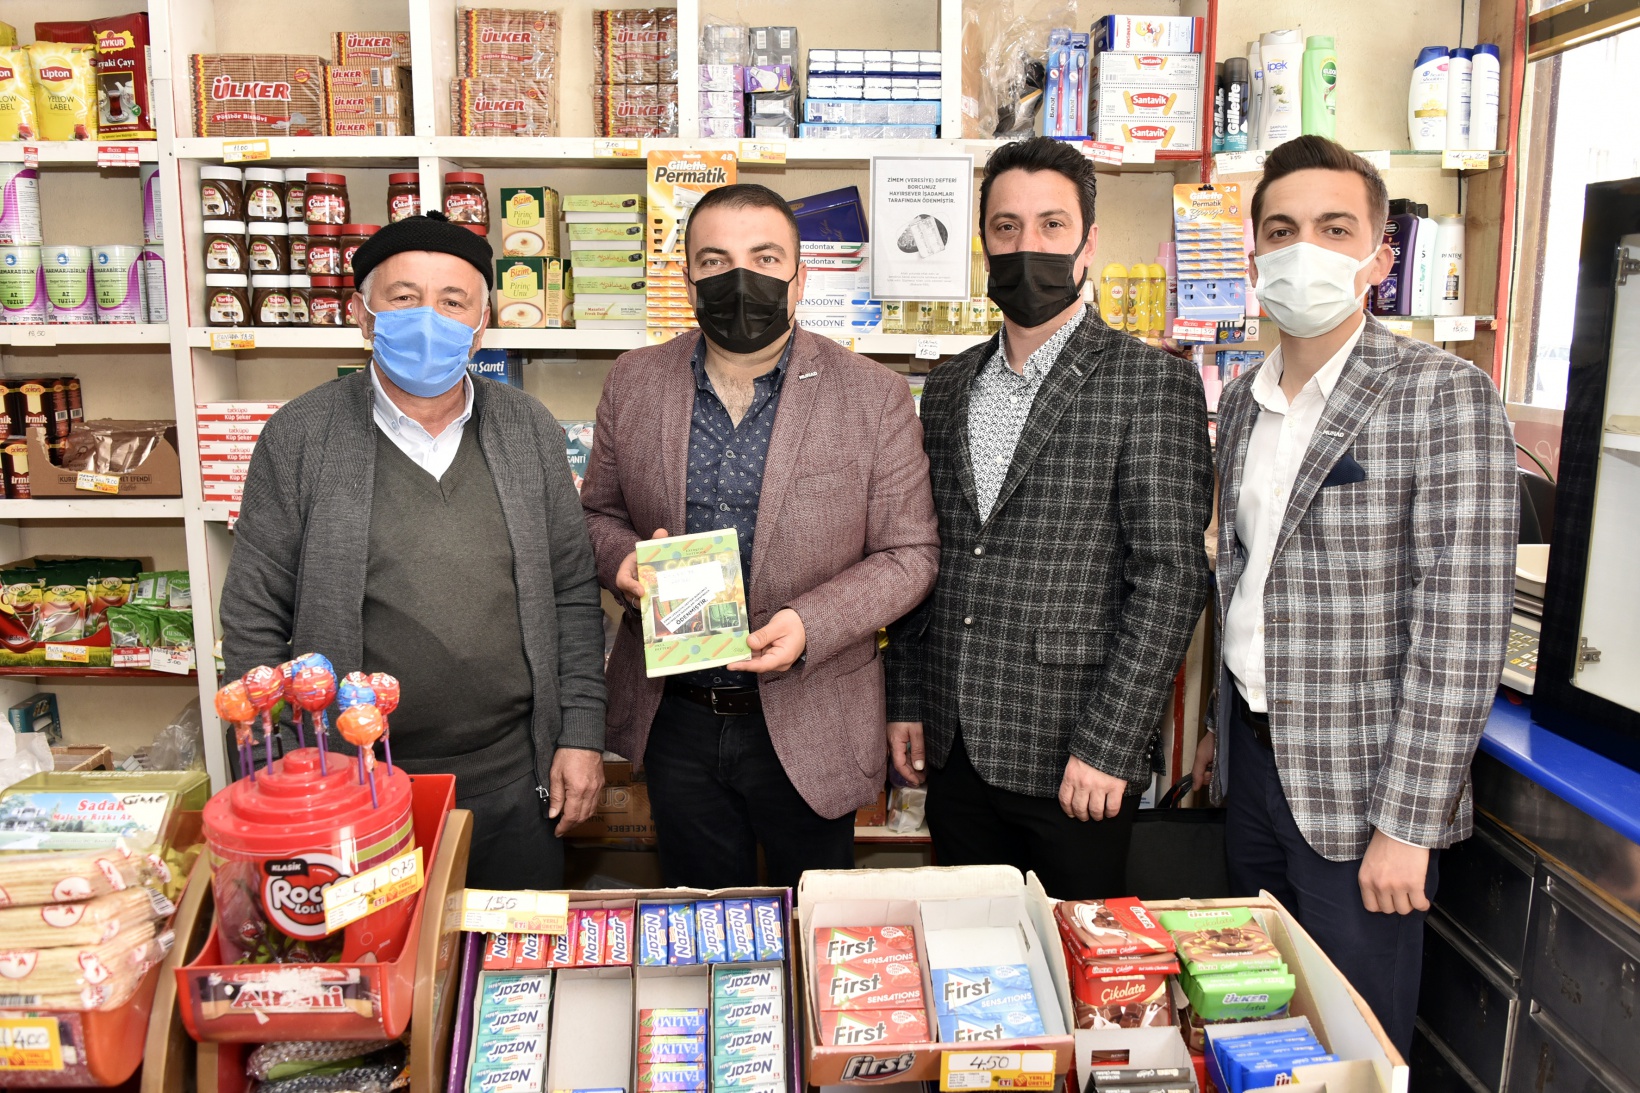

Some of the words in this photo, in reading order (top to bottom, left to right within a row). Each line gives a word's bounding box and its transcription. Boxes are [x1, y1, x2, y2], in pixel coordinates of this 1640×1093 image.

[347, 34, 392, 48] ÜLKER
[481, 27, 531, 44] ÜLKER
[616, 28, 668, 44] ÜLKER
[98, 60, 116, 68] ryaki
[118, 58, 135, 68] Çayı
[1139, 57, 1163, 65] Santavik
[1267, 60, 1288, 72] ipek
[42, 69, 70, 79] Lipton
[332, 68, 362, 78] ÜLKER
[1254, 69, 1264, 80] ip
[212, 75, 292, 101] ÜLKER
[334, 96, 364, 106] ÜLKER
[474, 97, 526, 112] ÜLKER
[1132, 95, 1167, 105] Santavik
[616, 101, 668, 118] ÜLKER
[1214, 87, 1225, 138] Gillette
[1226, 83, 1241, 135] Gillette
[336, 122, 366, 132] ÜLKER
[1131, 128, 1166, 137] Santavik
[721, 154, 733, 162] 48
[668, 160, 707, 171] Gillette
[655, 166, 726, 184] Permatik
[204, 188, 216, 196] orku
[1190, 192, 1223, 200] Gillette
[512, 196, 534, 207] Bizim
[1192, 200, 1222, 208] Permatik
[513, 210, 532, 220] Pirinç
[516, 218, 530, 226] Unu
[510, 266, 532, 278] Bizim
[510, 282, 531, 292] Pirinç
[311, 301, 339, 312] Çokokrem
[478, 361, 505, 373] Santi
[26, 415, 48, 424] irmik
[238, 434, 252, 442] Şeker
[12, 476, 30, 484] irmi
[230, 474, 240, 482] Küp
[676, 598, 708, 625] ÖDENMİŞTİR.
[606, 825, 647, 833] KELEBEK
[271, 862, 302, 872] KLASİK
[1130, 906, 1155, 929] ÜLKER
[1188, 910, 1232, 918] ÜLKER
[674, 912, 691, 958] Nazar
[702, 908, 720, 955] Nazar
[730, 908, 750, 954] Nazar
[759, 906, 778, 950] Nazar
[585, 918, 599, 964] Nazar
[614, 917, 626, 962] Nazar
[644, 914, 662, 960] Nazar
[494, 933, 508, 957] Naz
[524, 934, 538, 958] Naz
[556, 934, 568, 964] Naz
[827, 937, 875, 959] First
[863, 953, 914, 964] SENSATIONS
[494, 980, 542, 997] Nazar
[726, 973, 772, 990] Nazar
[830, 974, 880, 996] First
[868, 990, 920, 1004] SENSATIONS
[944, 978, 990, 1002] First
[1100, 982, 1146, 1004] Çikolata
[982, 992, 1032, 1008] SENSATIONS
[1222, 992, 1269, 1004] ÜLKER
[727, 1002, 772, 1018] Nazar
[492, 1010, 539, 1027] Nazar
[659, 1016, 700, 1028] FALIM
[728, 1031, 773, 1048] Nazar
[834, 1021, 885, 1046] First
[954, 1024, 1002, 1041] First
[489, 1040, 537, 1056] Nazar
[658, 1044, 700, 1055] FALIM
[728, 1059, 773, 1076] Nazar
[483, 1068, 531, 1085] Nazar
[658, 1071, 700, 1082] FALIM
